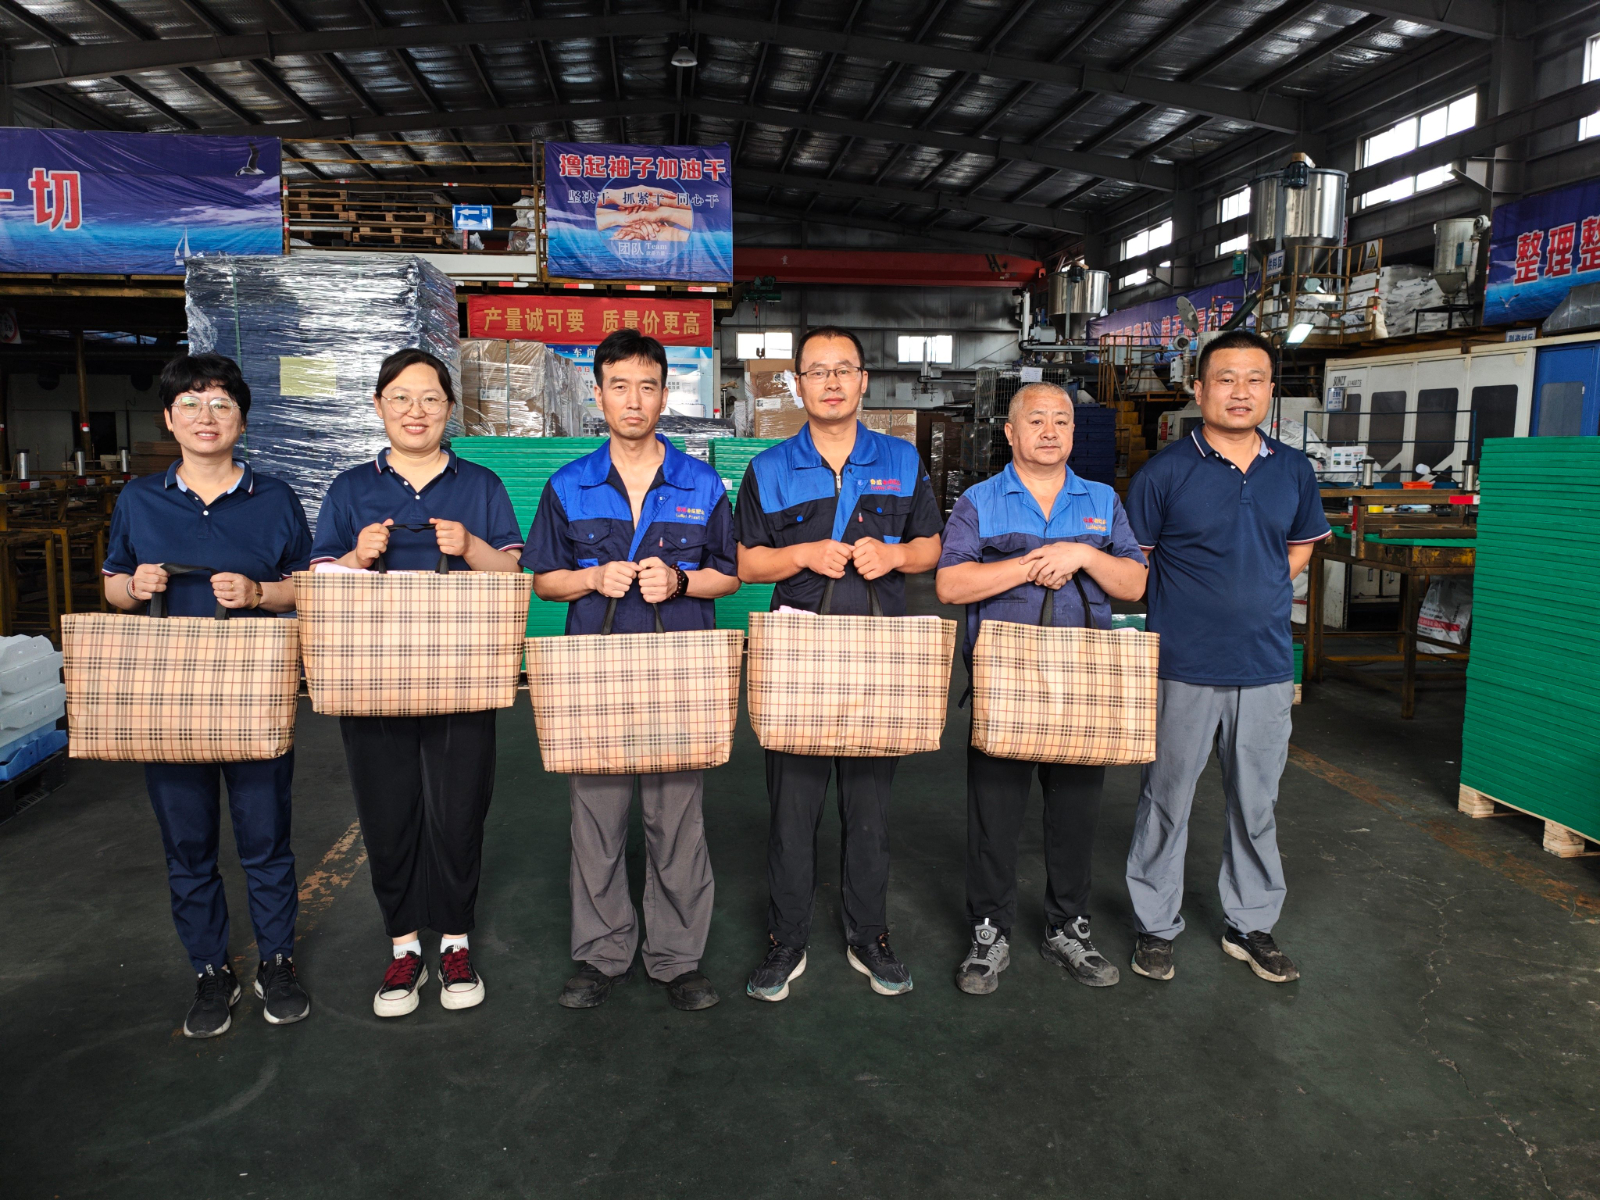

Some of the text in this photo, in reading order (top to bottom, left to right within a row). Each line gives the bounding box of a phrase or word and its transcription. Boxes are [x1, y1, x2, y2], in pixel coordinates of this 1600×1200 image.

[559, 153, 727, 182] 撸起袖子加油干
[0, 167, 82, 232] 切
[567, 189, 720, 208] 坚决干 抓紧干 同心干
[618, 242, 667, 256] 团队 Team
[483, 306, 701, 336] 产量诚可要 质量价更高
